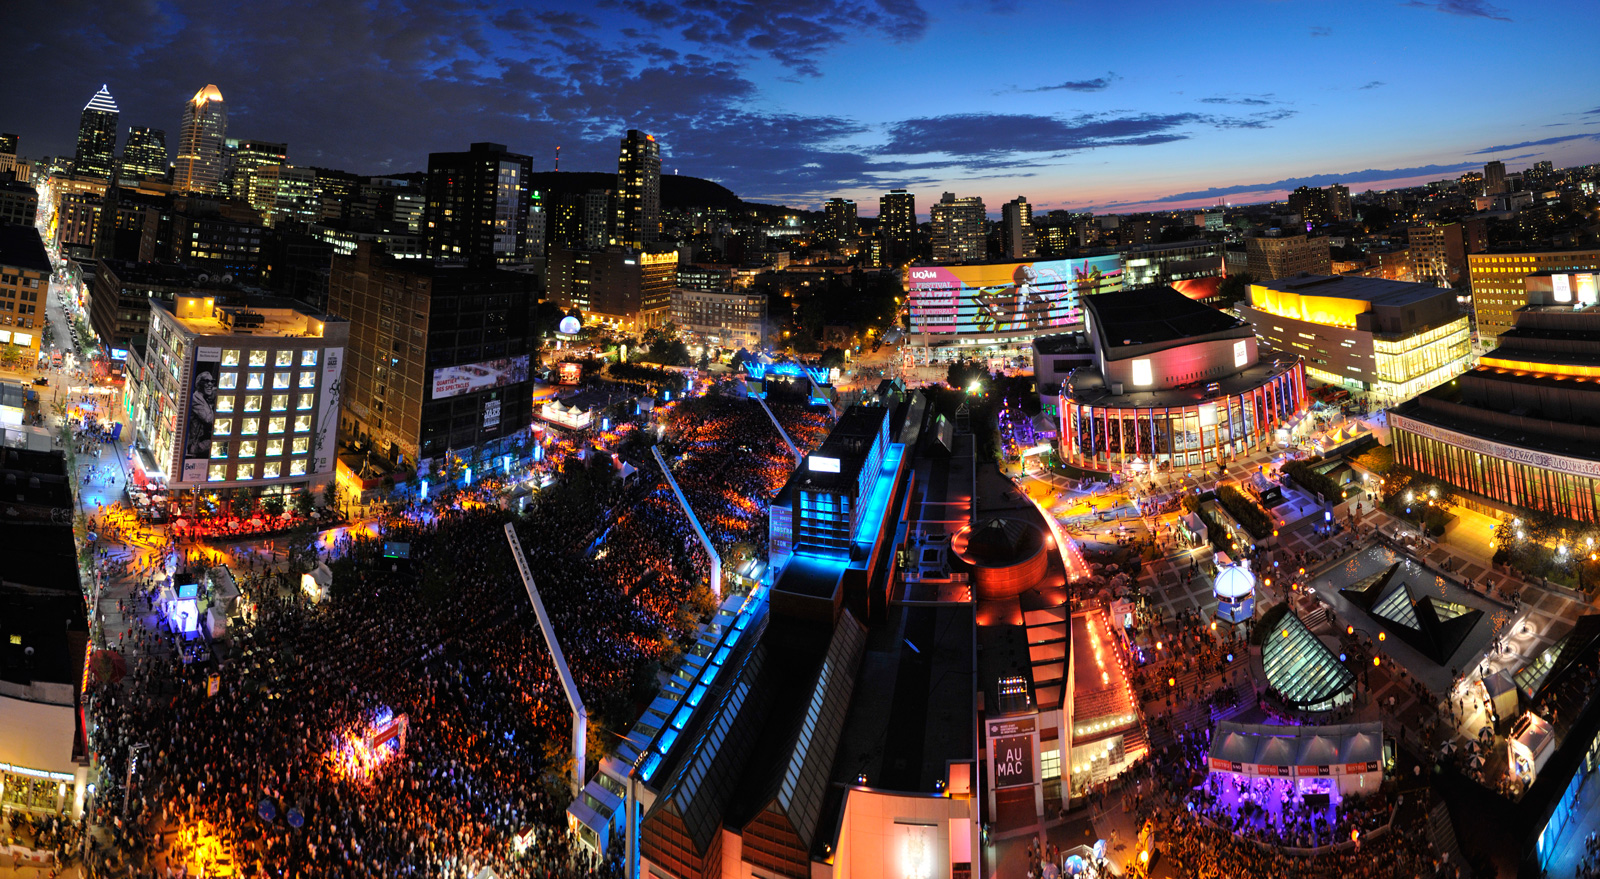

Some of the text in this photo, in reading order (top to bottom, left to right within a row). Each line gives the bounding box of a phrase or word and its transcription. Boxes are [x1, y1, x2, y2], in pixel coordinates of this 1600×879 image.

[916, 291, 953, 305] JAZZ
[437, 378, 457, 386] QUARTIER
[445, 382, 469, 391] SPECTACLES
[484, 408, 500, 419] JAZZ
[1401, 420, 1434, 437] FESTIVAL
[1509, 448, 1533, 463] JAZZ
[1006, 748, 1022, 762] AU
[998, 762, 1022, 776] MAC
